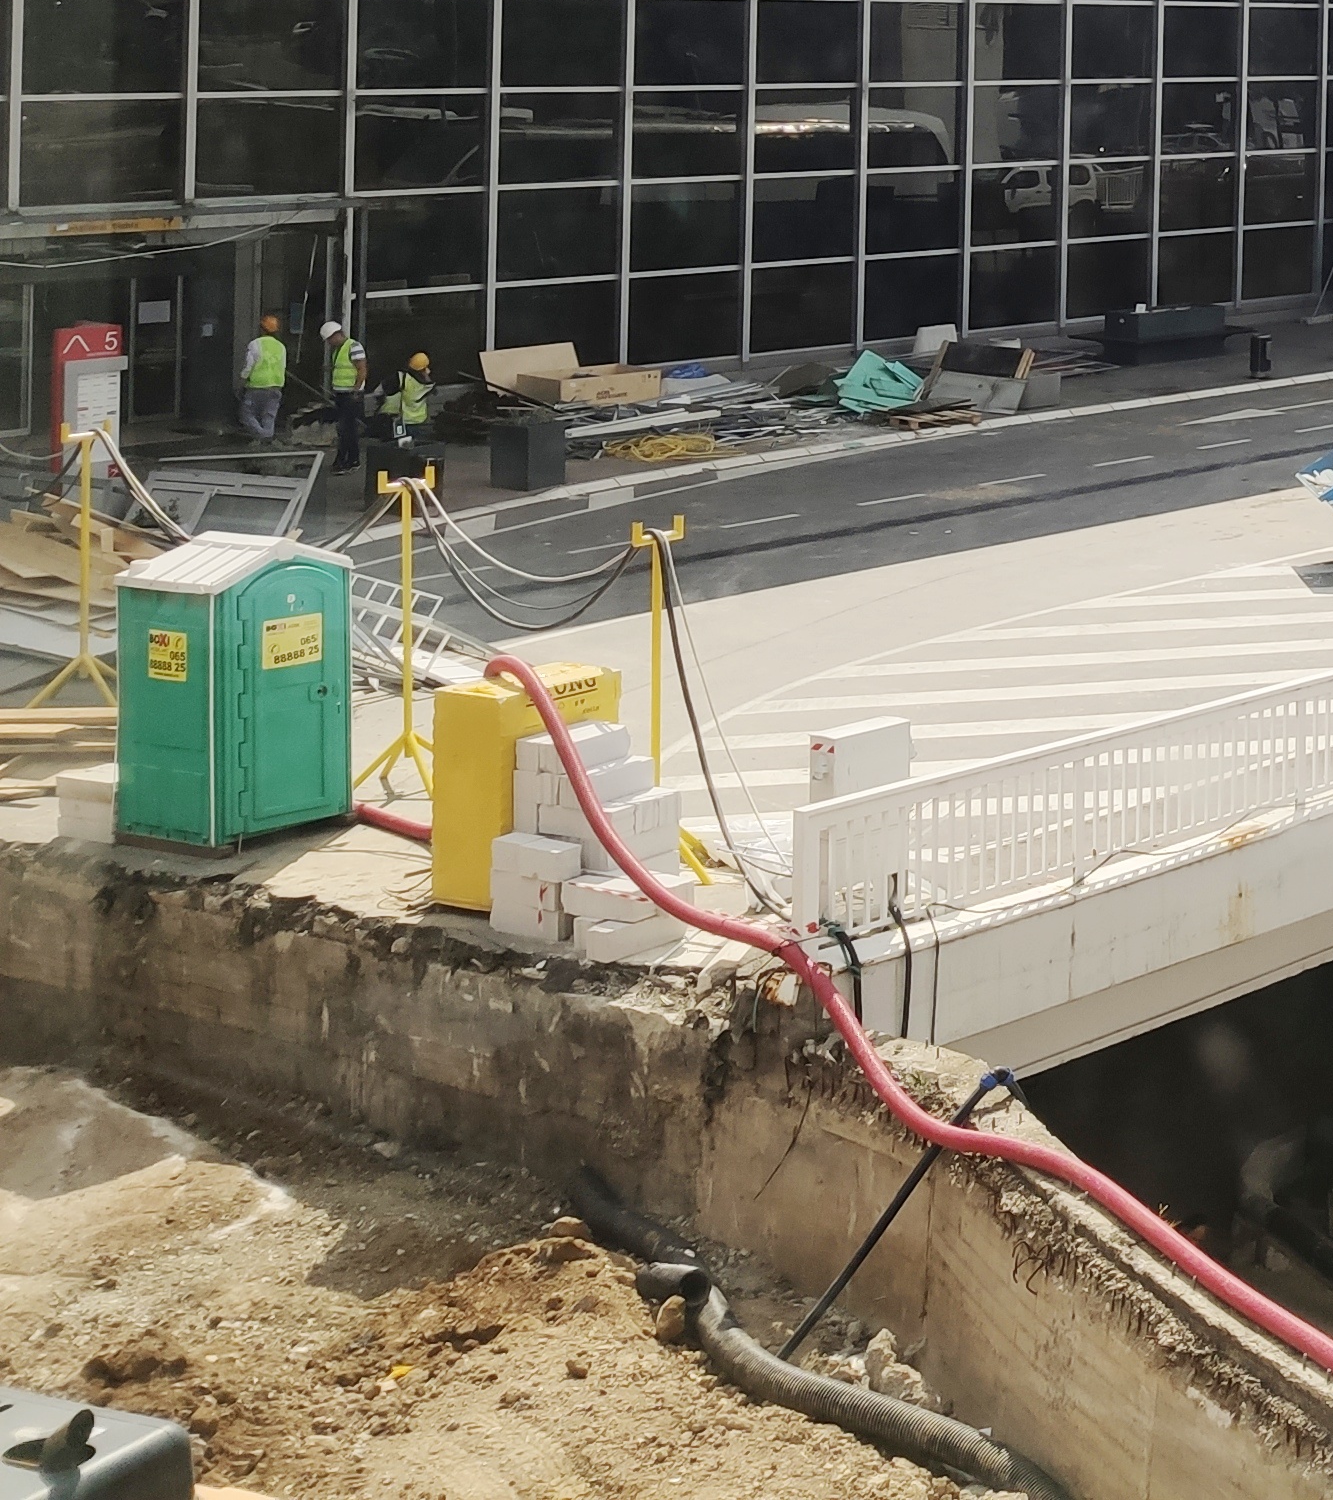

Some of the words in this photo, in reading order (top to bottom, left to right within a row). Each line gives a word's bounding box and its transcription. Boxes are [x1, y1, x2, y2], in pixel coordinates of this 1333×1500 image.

[104, 331, 118, 351] 5
[300, 634, 317, 646] 065
[169, 651, 186, 661] 065
[273, 648, 305, 665] 88888
[308, 644, 320, 656] 25
[174, 663, 186, 672] 25
